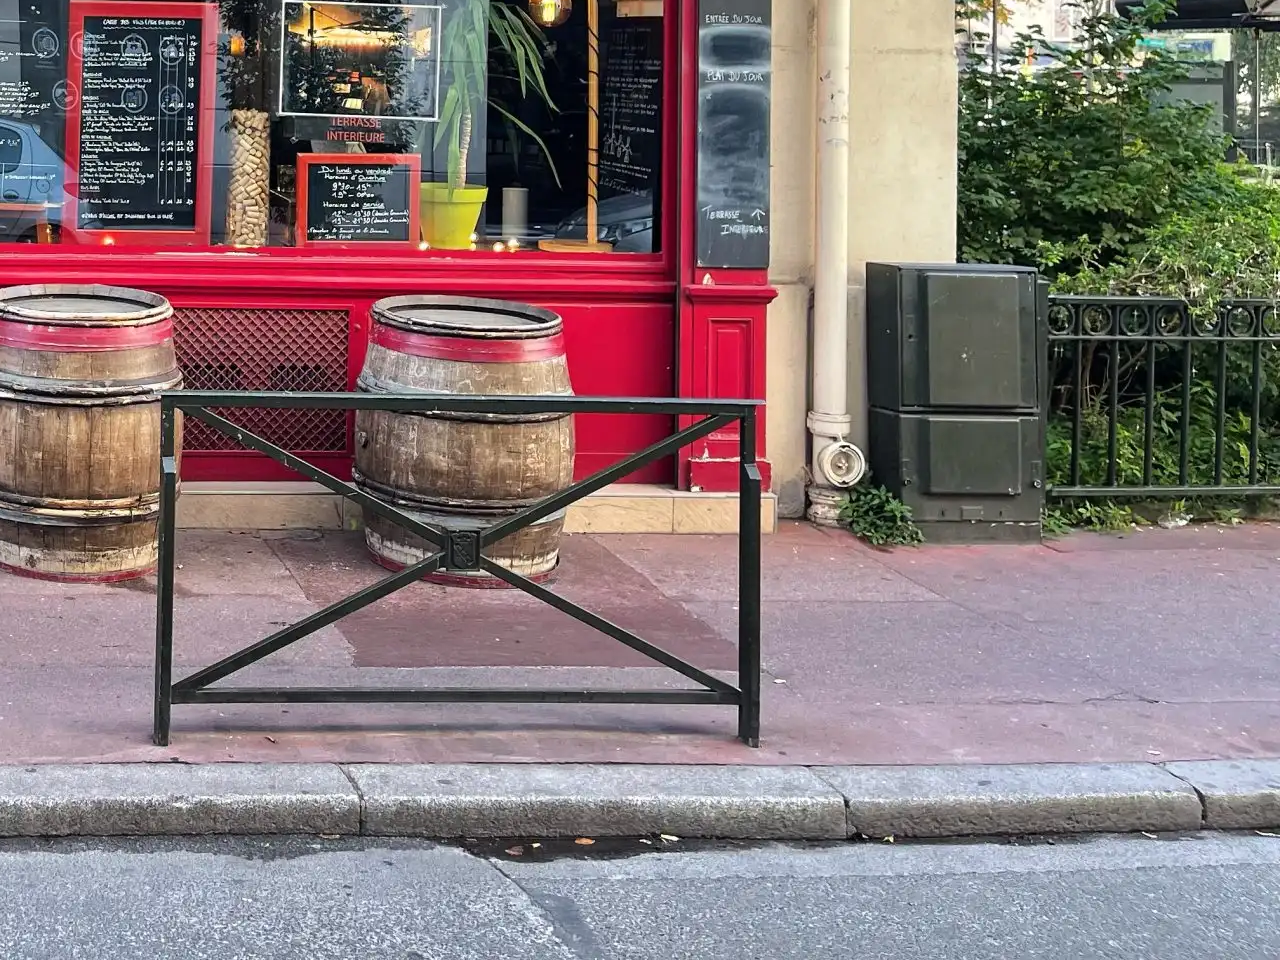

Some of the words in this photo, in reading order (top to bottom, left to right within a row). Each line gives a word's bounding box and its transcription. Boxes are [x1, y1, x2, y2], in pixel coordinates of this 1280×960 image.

[705, 12, 730, 24] ENTRÉE
[731, 14, 743, 24] DU
[744, 14, 763, 24] JOUR
[728, 71, 741, 82] DU
[743, 70, 764, 82] JOUR
[331, 116, 382, 129] TERRASSE
[326, 131, 385, 143] INTERIEURE
[351, 200, 360, 208] de
[701, 204, 740, 221] TERRASSE
